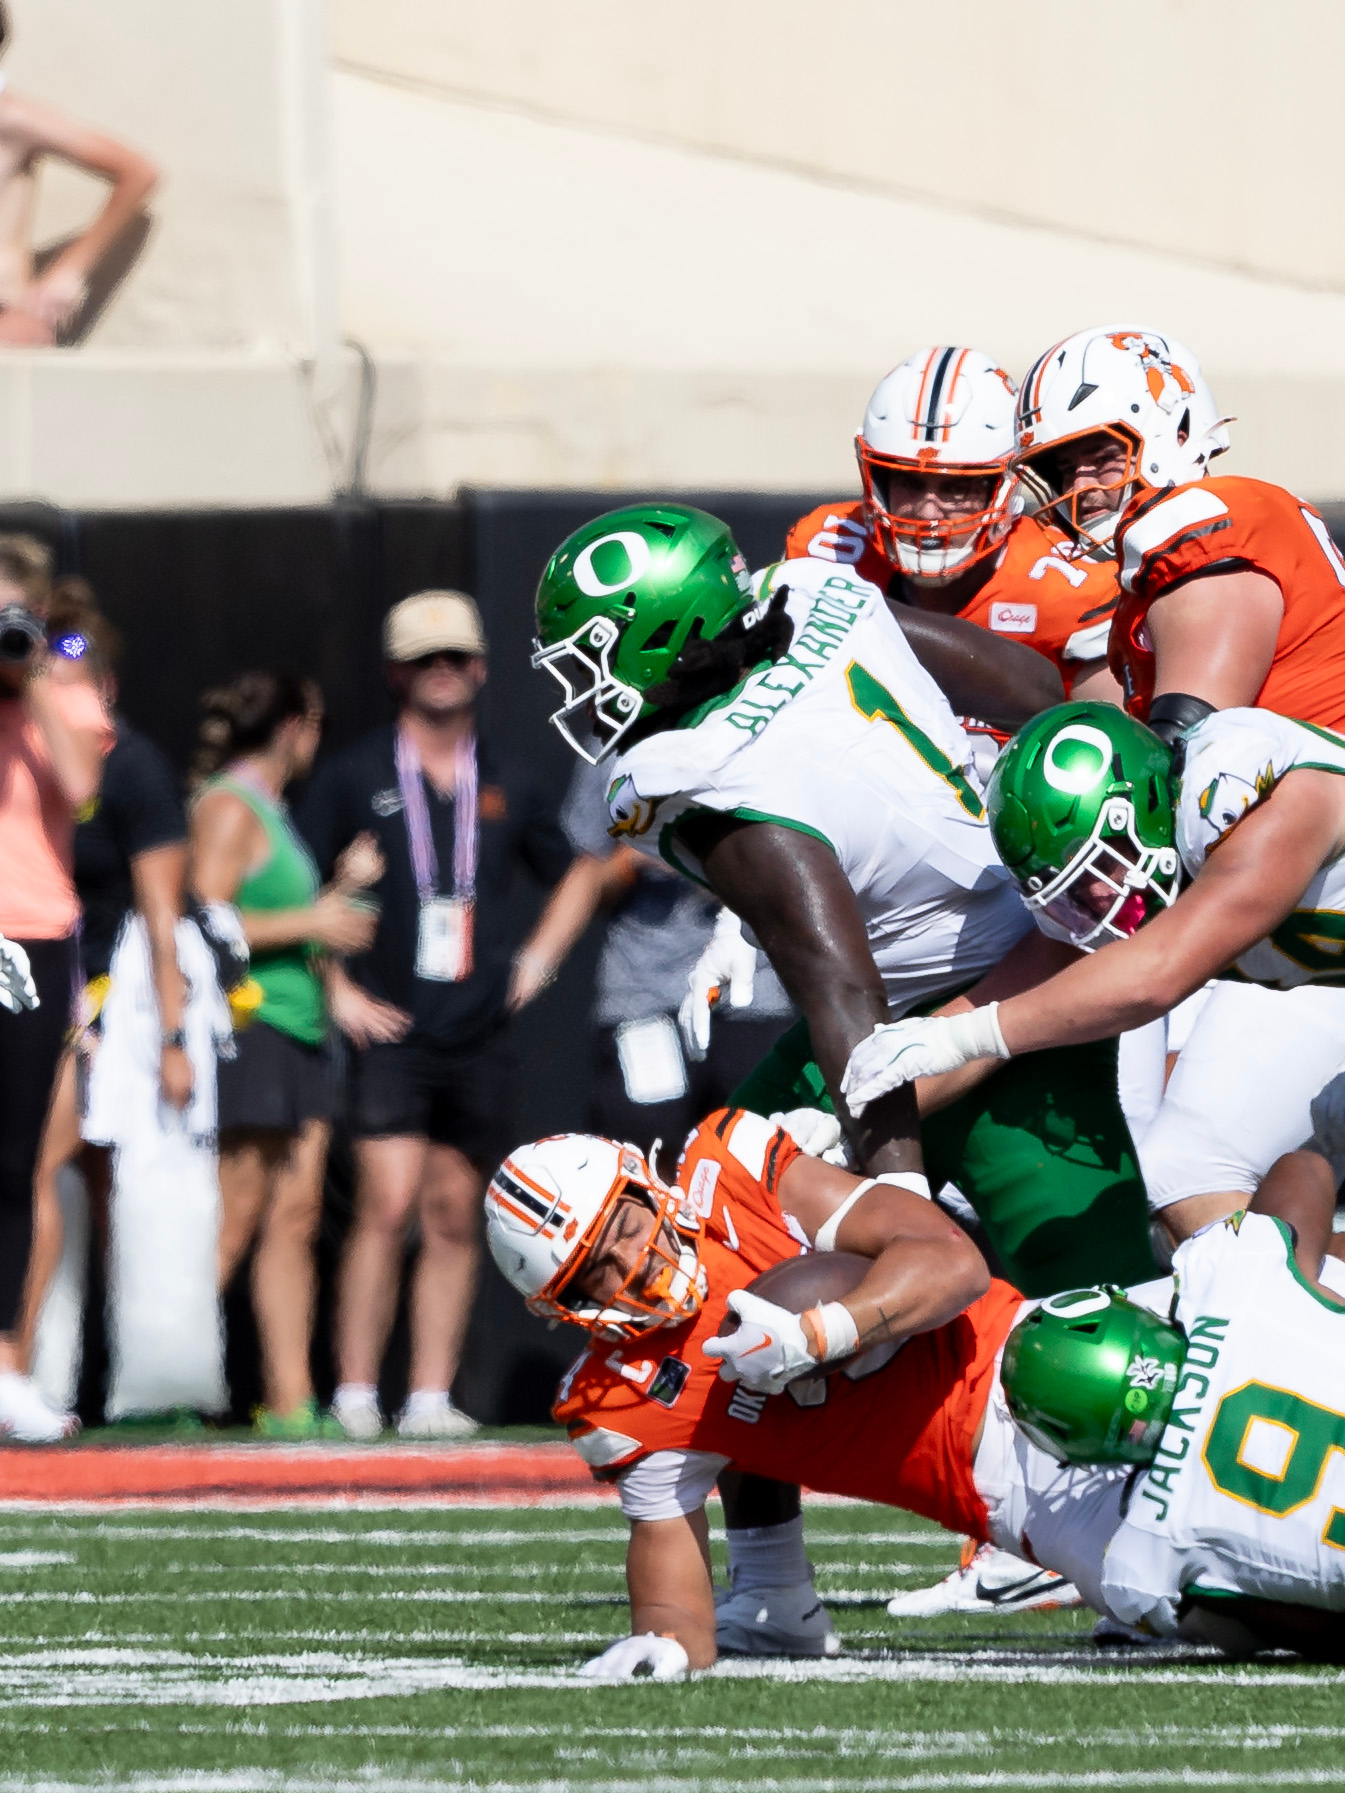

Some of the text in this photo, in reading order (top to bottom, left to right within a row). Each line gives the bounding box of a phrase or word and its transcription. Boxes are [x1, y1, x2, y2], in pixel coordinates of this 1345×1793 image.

[573, 531, 650, 597] O
[723, 576, 875, 736] ALEXANDER
[844, 658, 986, 823] 1
[1043, 724, 1114, 795] O
[1041, 1289, 1111, 1319] O
[1142, 1315, 1231, 1522] JACKSON
